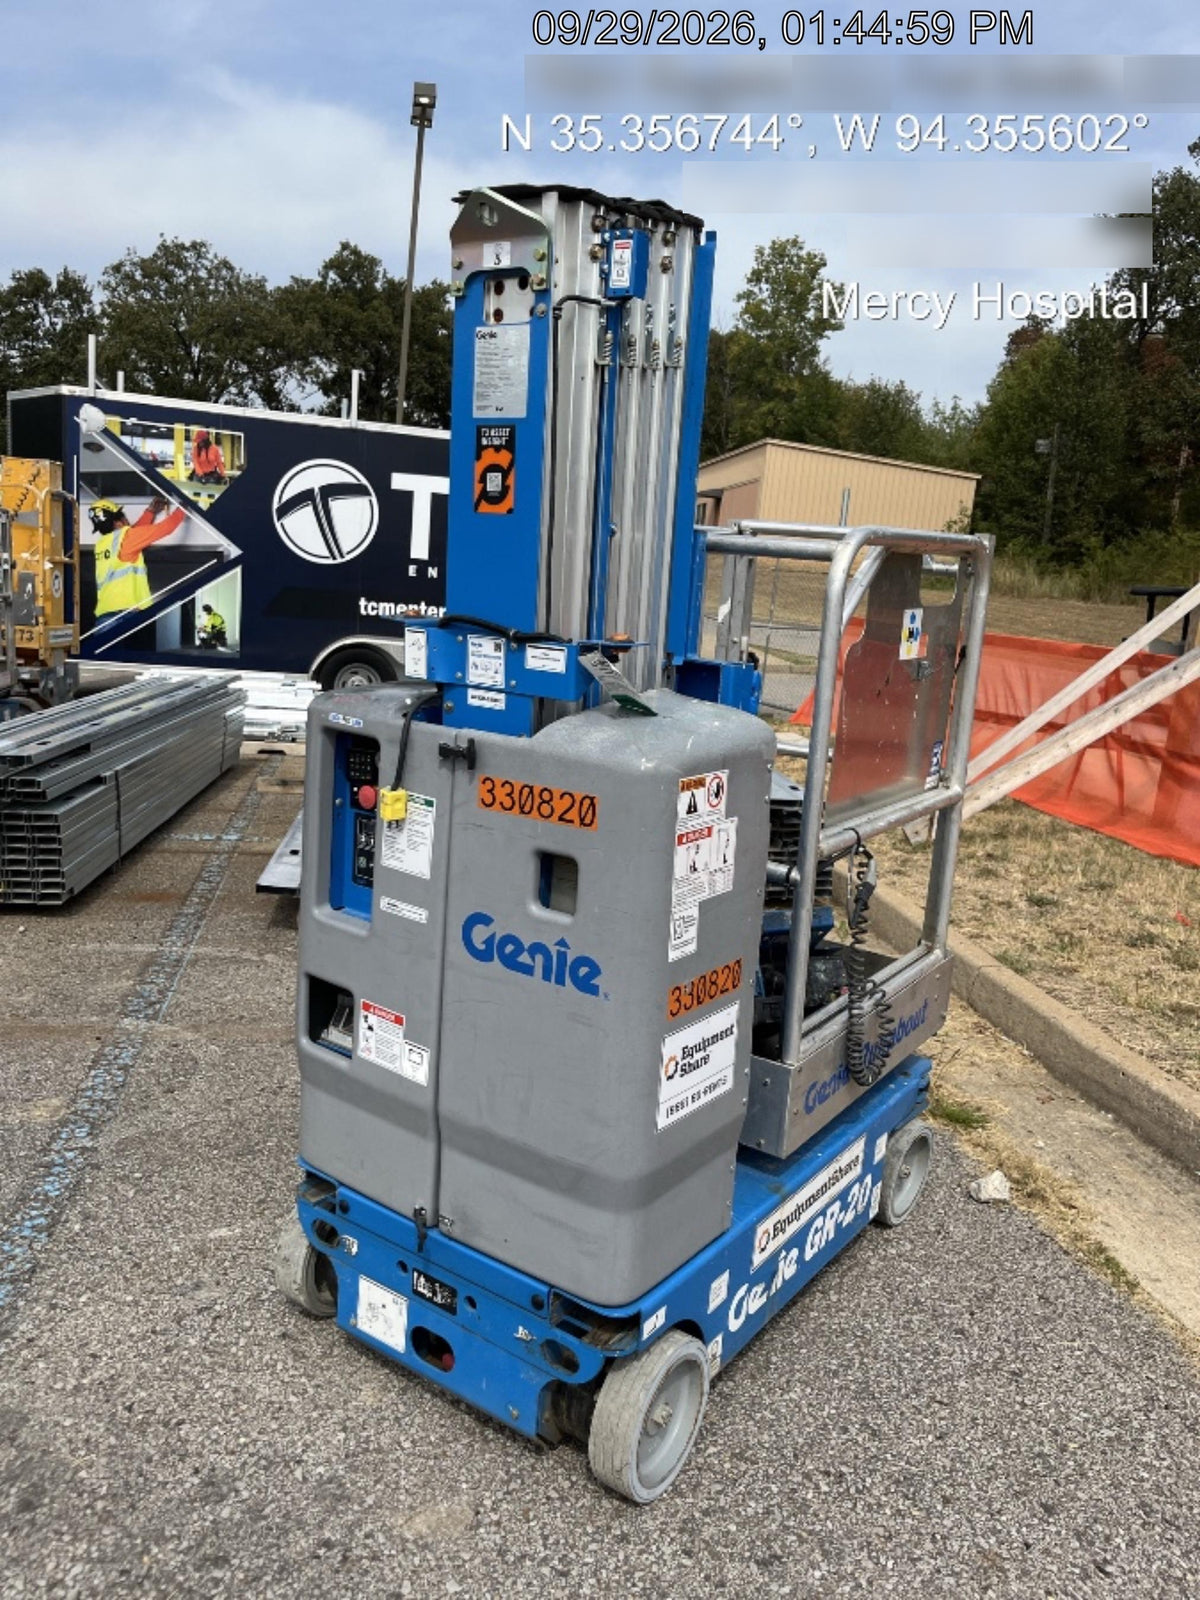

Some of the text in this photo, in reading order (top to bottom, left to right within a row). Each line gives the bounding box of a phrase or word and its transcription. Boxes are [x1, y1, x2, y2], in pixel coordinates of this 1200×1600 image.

[481, 777, 597, 828] 330820
[462, 912, 602, 997] Genie
[670, 958, 742, 1018] 330820
[679, 1054, 710, 1078] Share
[681, 1024, 734, 1061] Equipment
[804, 1063, 850, 1115] Geni
[772, 1154, 860, 1241] EquipmentShare
[804, 1173, 872, 1262] GR-20
